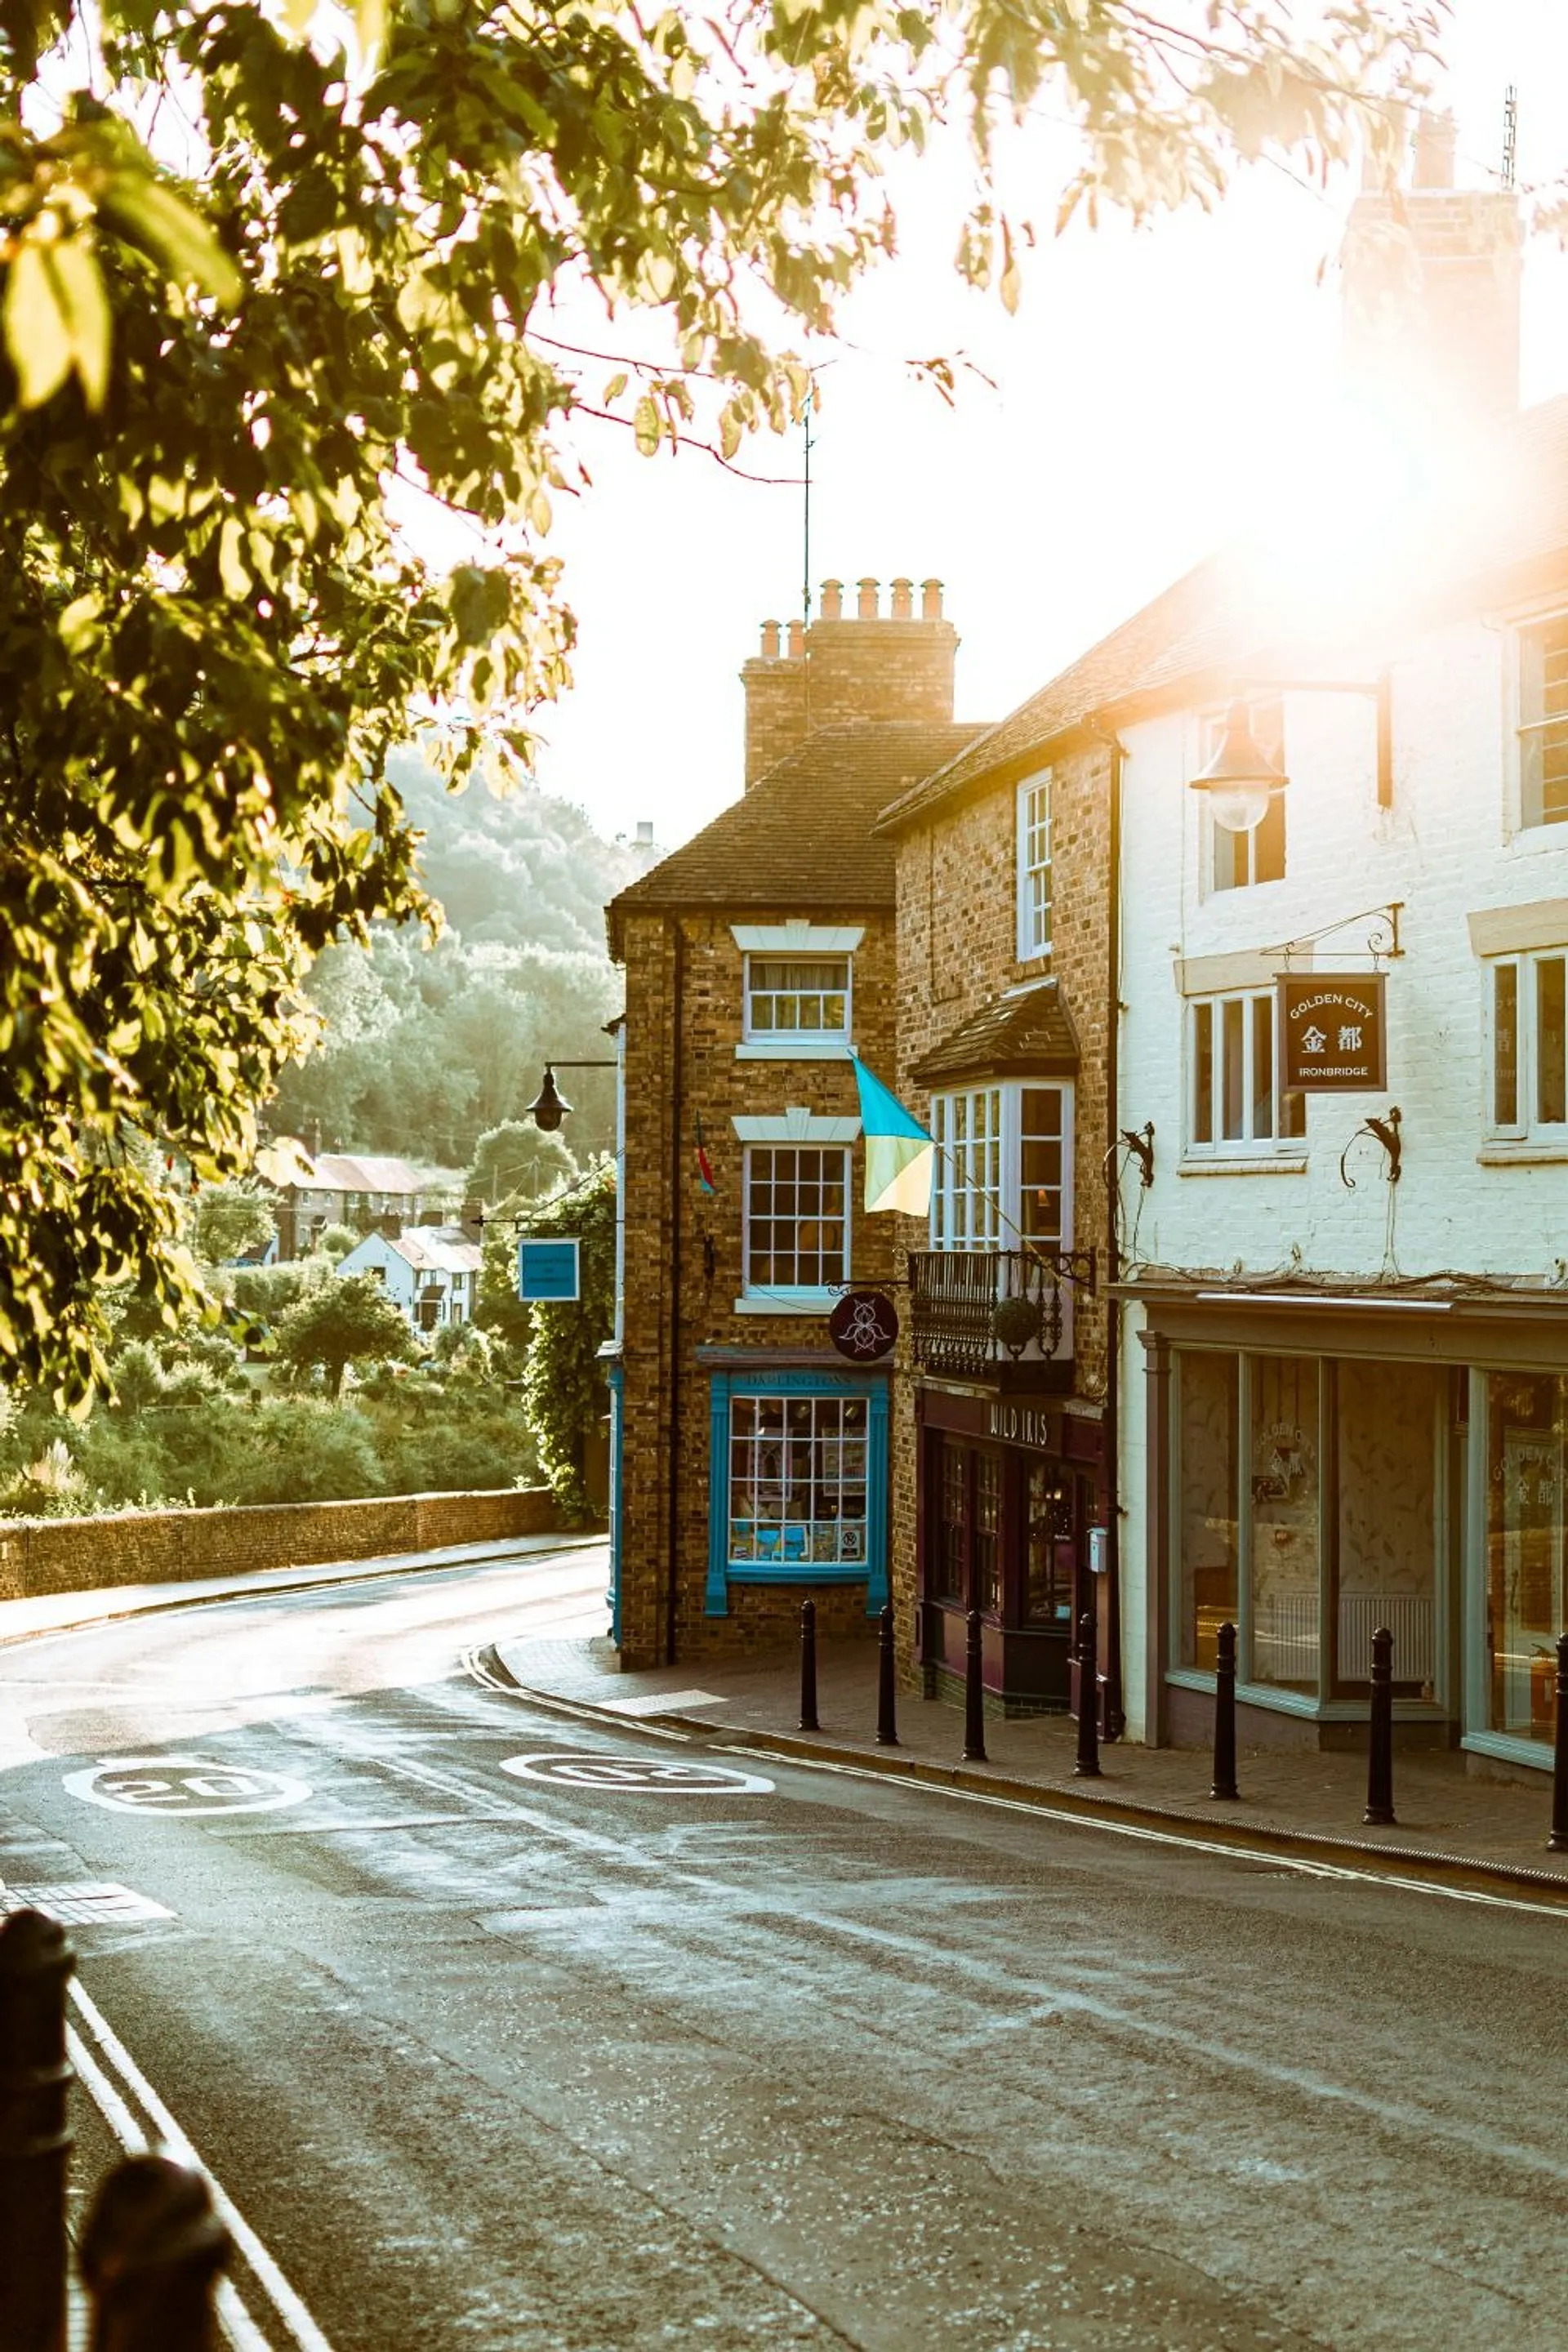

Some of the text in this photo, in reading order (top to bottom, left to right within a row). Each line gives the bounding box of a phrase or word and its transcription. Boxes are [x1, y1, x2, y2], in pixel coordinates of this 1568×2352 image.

[1290, 994, 1374, 1019] GOLDEN CITY
[1300, 1025, 1362, 1054] 金都
[1298, 1067, 1368, 1077] IRONBRIDGE
[991, 1403, 1047, 1446] WILD IRIS
[102, 1775, 266, 1803] 20
